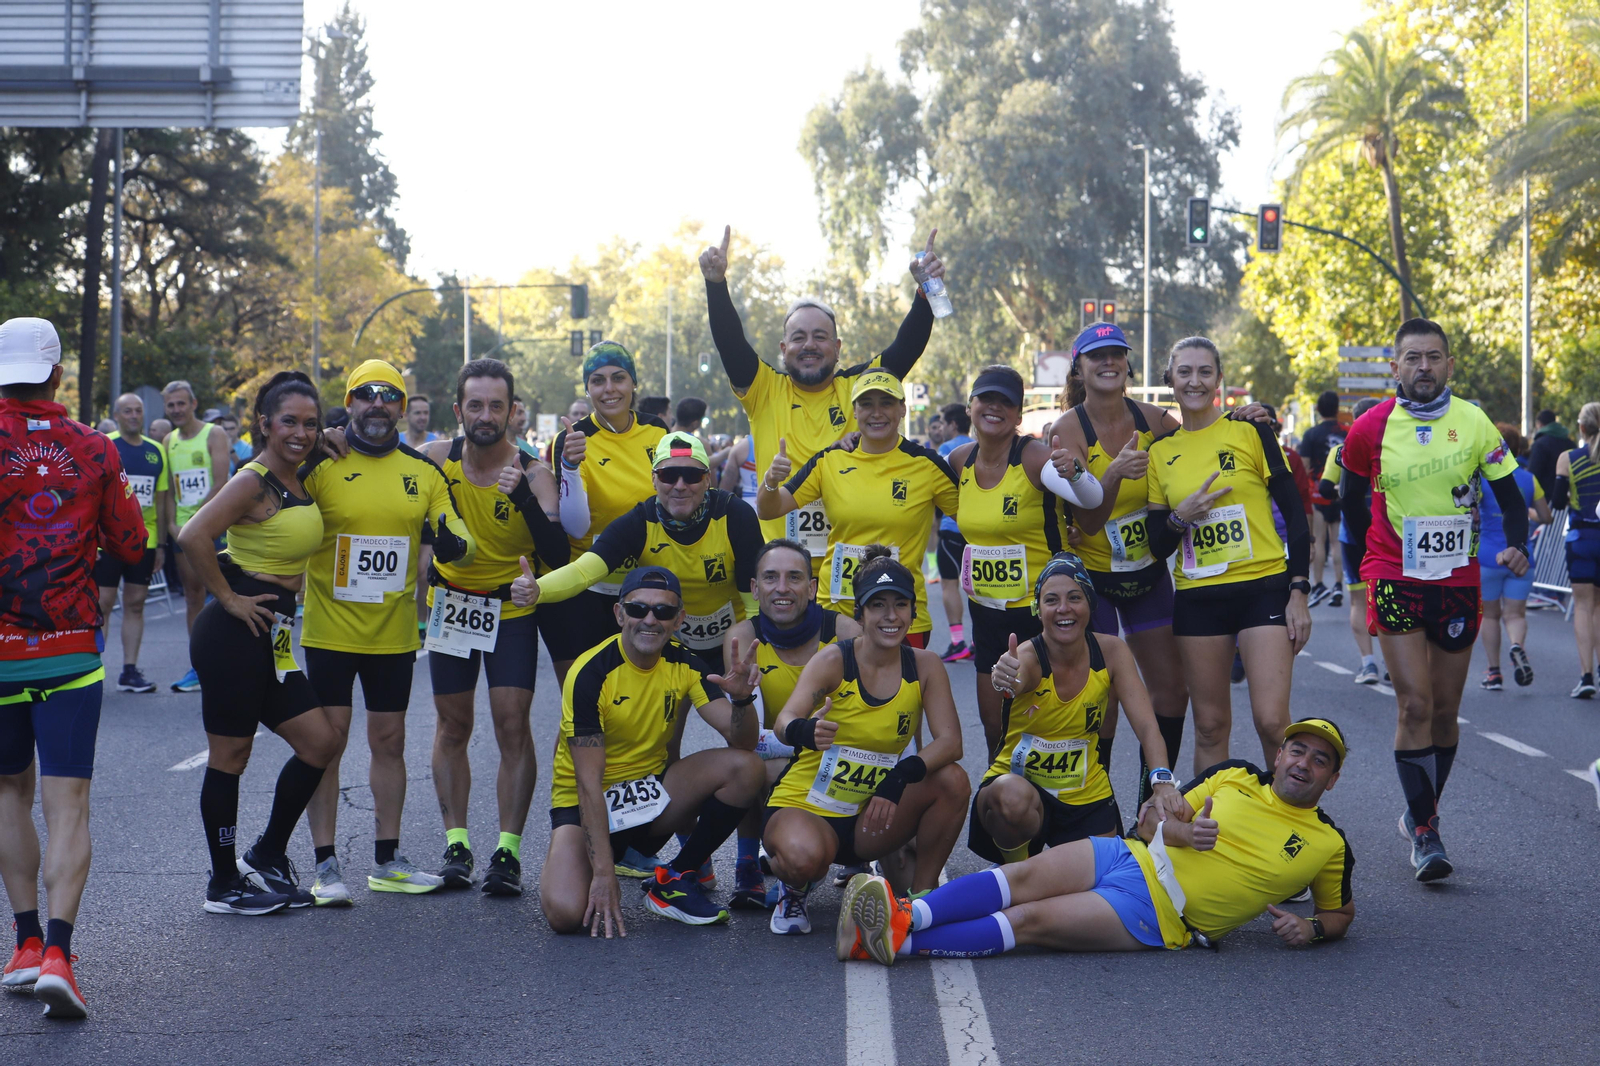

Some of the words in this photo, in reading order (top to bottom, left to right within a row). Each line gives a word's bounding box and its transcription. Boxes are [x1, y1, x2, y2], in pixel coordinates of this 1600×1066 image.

[1407, 446, 1472, 482] Cabras
[181, 477, 205, 490] 1441
[799, 511, 833, 531] 28
[1112, 536, 1122, 555] CAJÓN
[1193, 520, 1244, 549] 4988
[1417, 529, 1464, 552] 4381
[358, 550, 398, 572] 500
[972, 560, 1022, 582] 5085
[453, 594, 477, 604] IMDCO
[444, 604, 494, 632] 2468
[681, 614, 732, 638] 2465
[849, 751, 876, 761] IMDECO
[1025, 750, 1082, 773] 2447
[821, 763, 831, 782] CAJÓN
[606, 780, 660, 812] 2453
